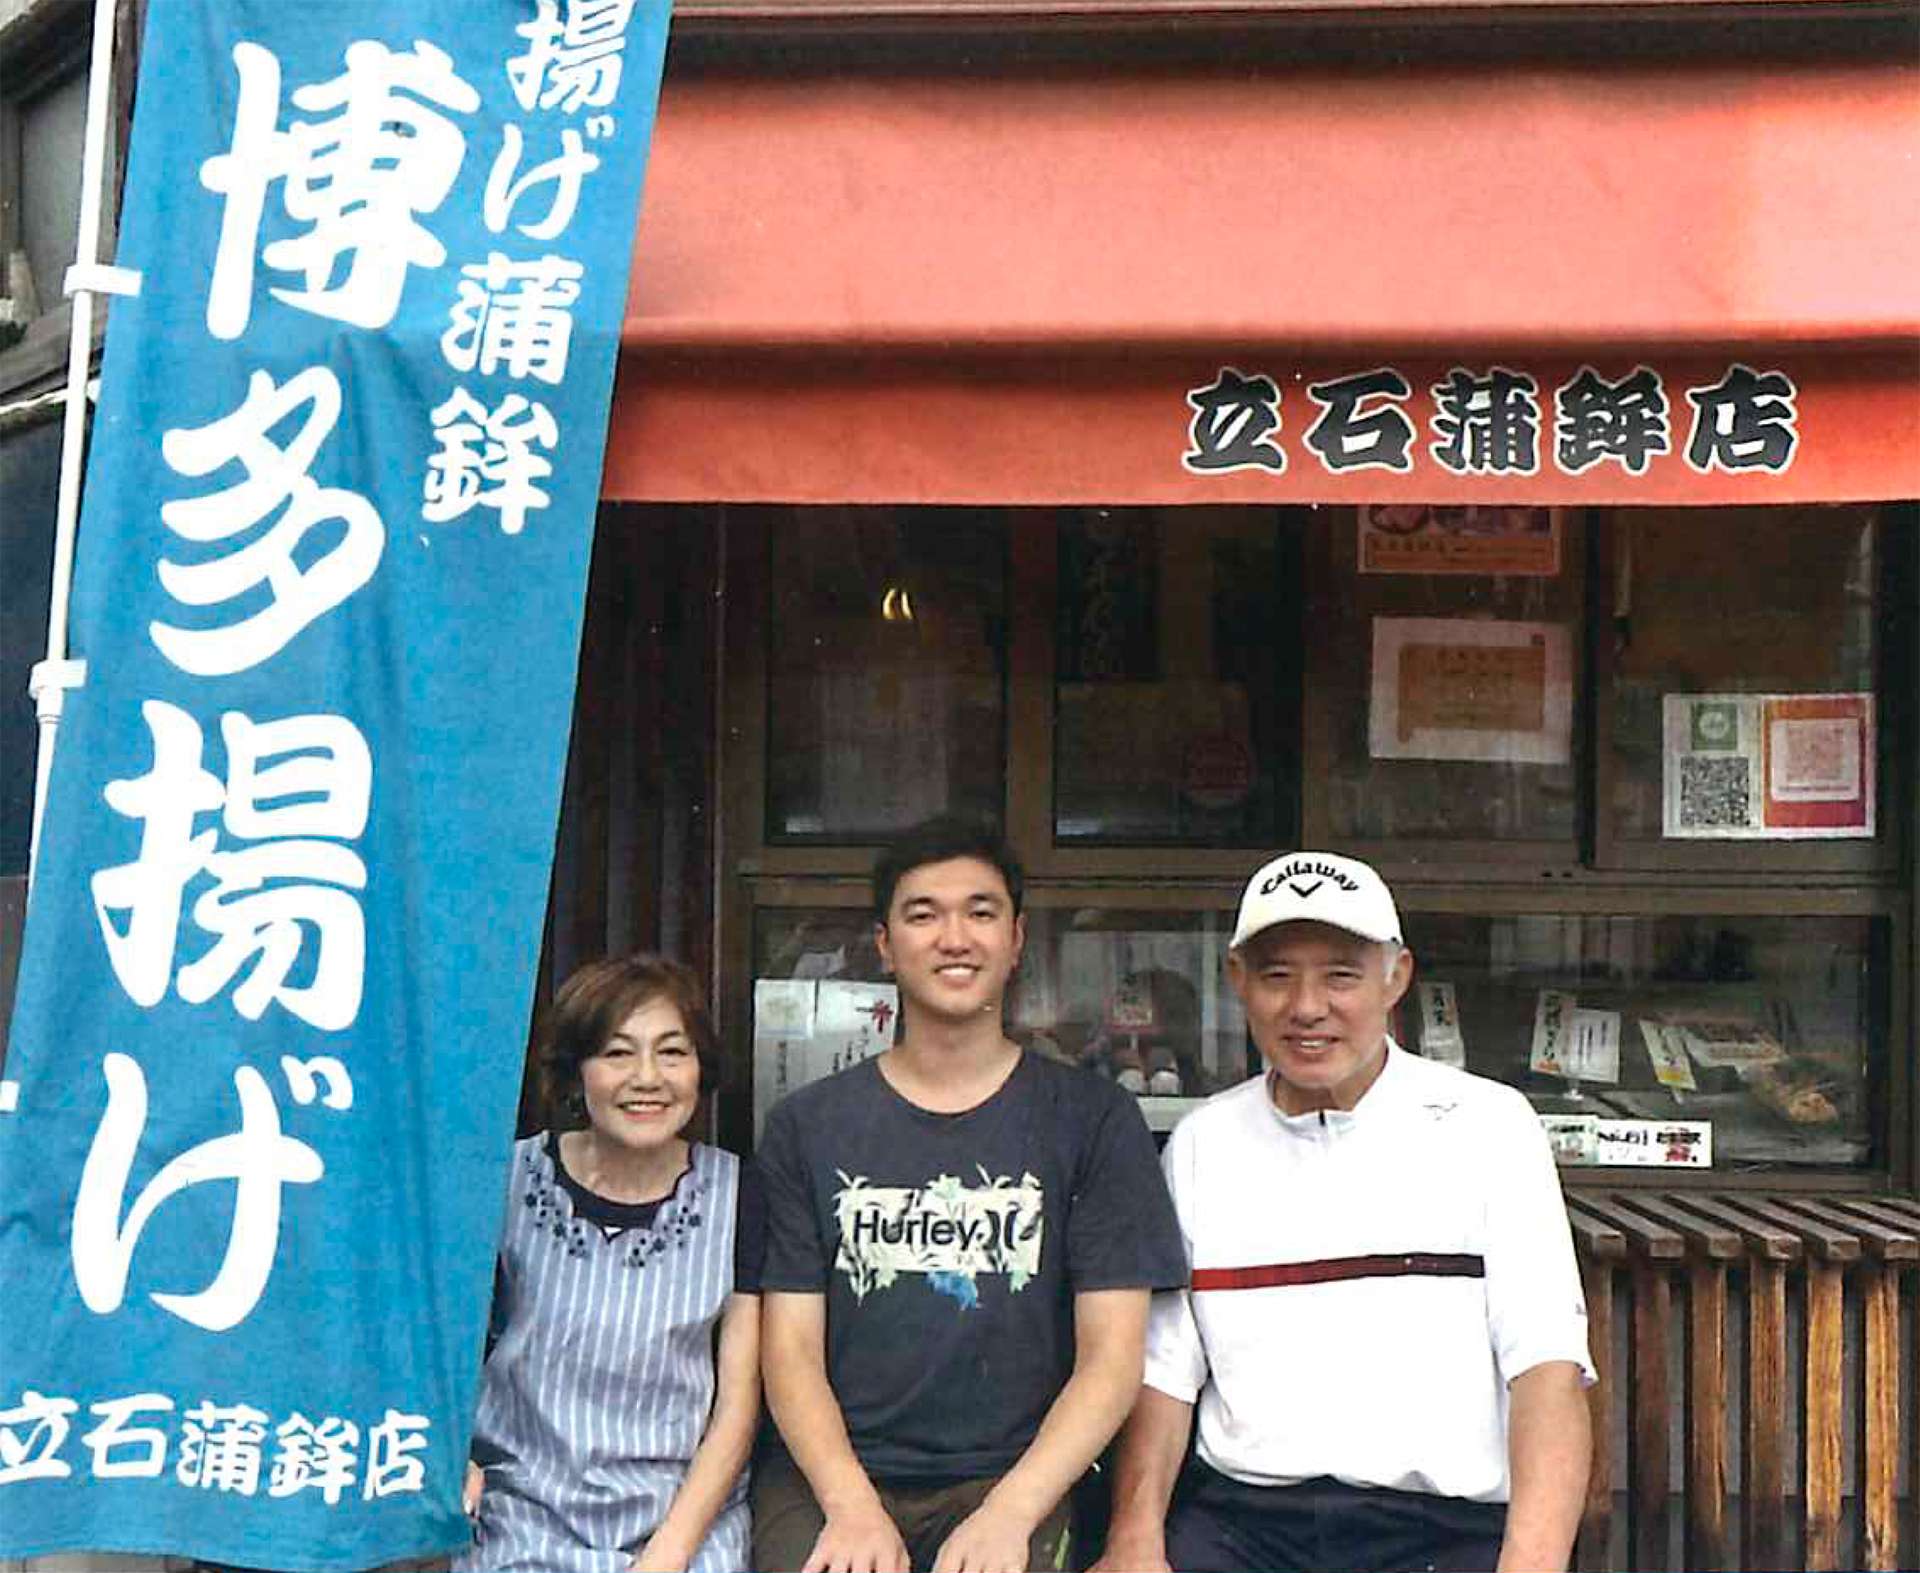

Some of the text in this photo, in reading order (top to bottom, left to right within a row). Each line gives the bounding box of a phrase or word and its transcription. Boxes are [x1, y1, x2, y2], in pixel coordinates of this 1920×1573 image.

[1183, 365, 1799, 475] 立石蒲鉾店
[71, 40, 480, 1331] 博多揚げ
[1260, 861, 1359, 895] Callaway
[0, 1391, 431, 1504] 立石蒲鉾店
